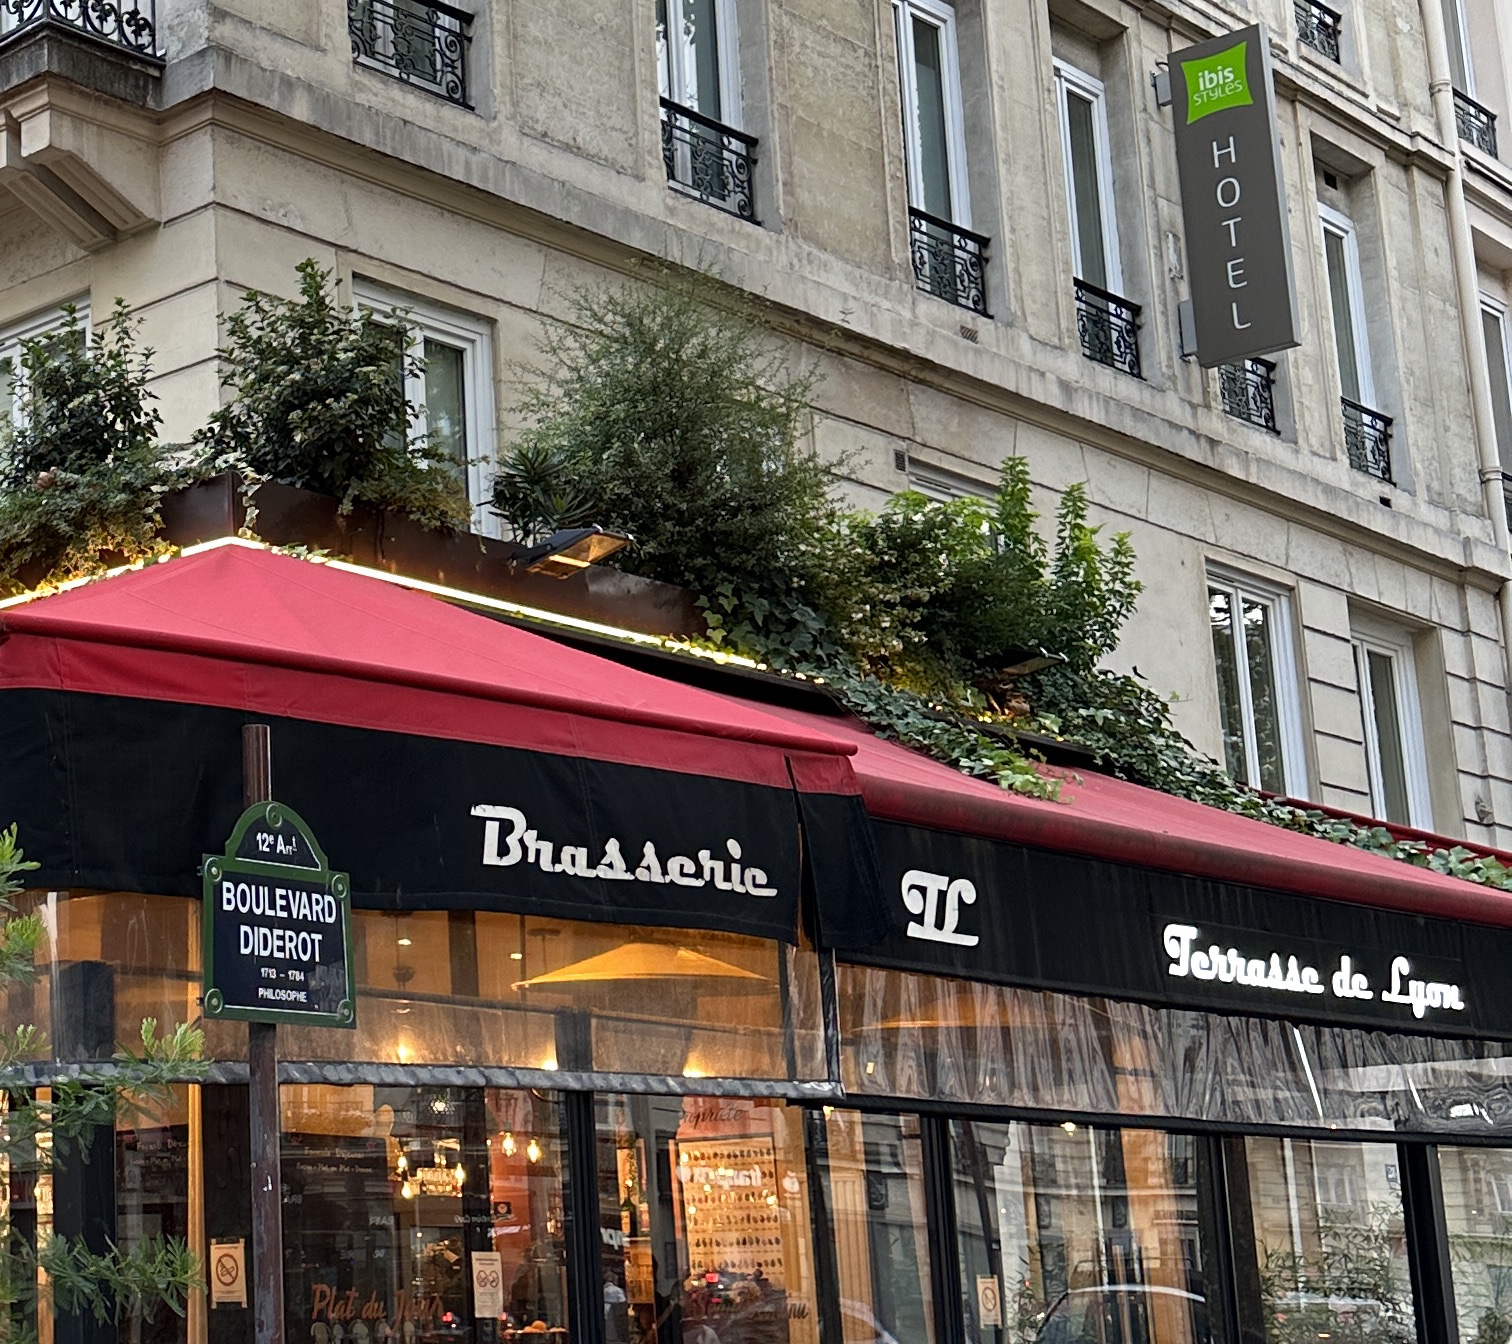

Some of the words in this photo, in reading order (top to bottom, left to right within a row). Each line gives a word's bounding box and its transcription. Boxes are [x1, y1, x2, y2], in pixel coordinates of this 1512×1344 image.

[1197, 65, 1235, 91] ibis
[1212, 135, 1252, 330] HOTEL
[470, 803, 778, 898] Brasserie
[222, 881, 337, 924] BOULEVARD
[239, 925, 323, 963] DIDEROT
[1162, 922, 1325, 995] Terrasse
[1332, 954, 1374, 1000] de
[1381, 955, 1466, 1020] Lyon
[258, 987, 308, 1003] PHILOSOPHE
[311, 1283, 360, 1321] Plat
[363, 1290, 387, 1320] du
